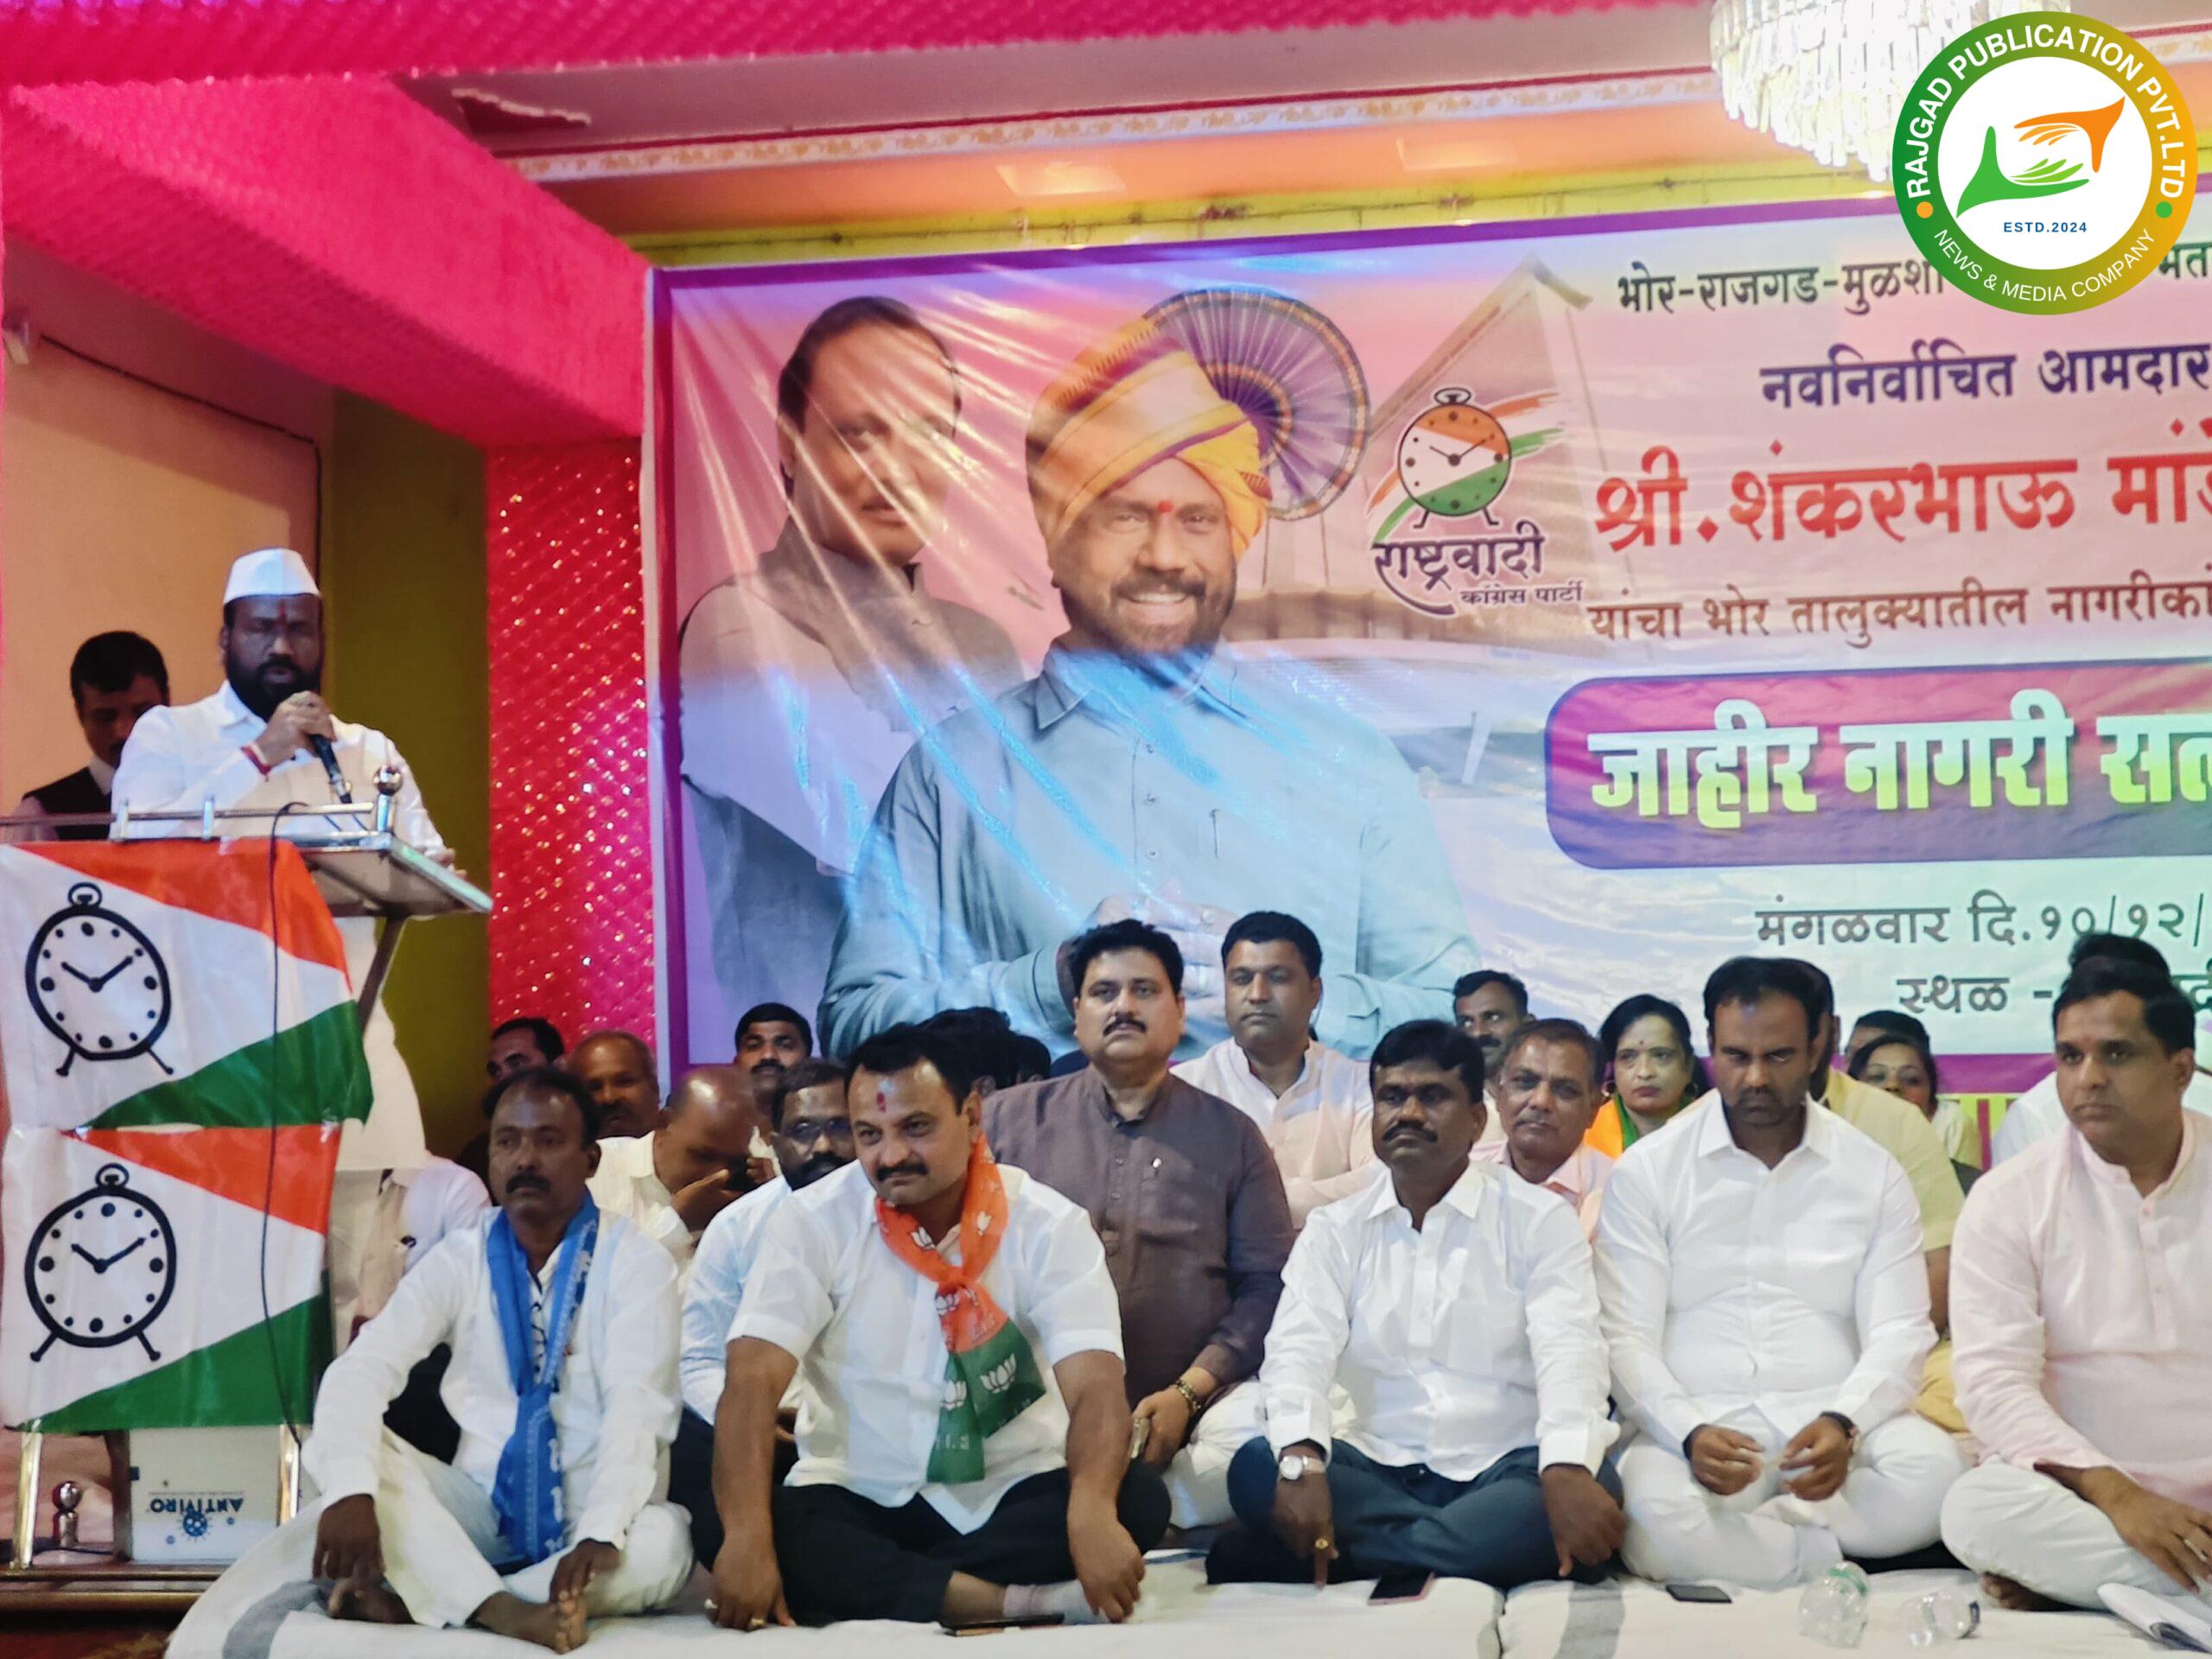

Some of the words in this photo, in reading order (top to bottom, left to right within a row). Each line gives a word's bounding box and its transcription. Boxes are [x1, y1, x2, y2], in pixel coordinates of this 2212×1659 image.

[2037, 343, 2211, 395] आमदार
[2107, 417, 2212, 524] मां
[1371, 520, 1546, 614] राष्ट्रवादी
[1535, 580, 1583, 602] पार्टी
[1586, 588, 1682, 640] यांचा
[1702, 584, 1770, 636] भोर
[1786, 575, 2029, 649] तालुक्यातील
[1586, 699, 1819, 830] जाहीर
[1840, 689, 2075, 810] नागरी
[1755, 893, 1950, 946] मंगळवार
[1897, 975, 2010, 1014] स्थळ
[149, 1497, 245, 1514] ANTIVIRO
